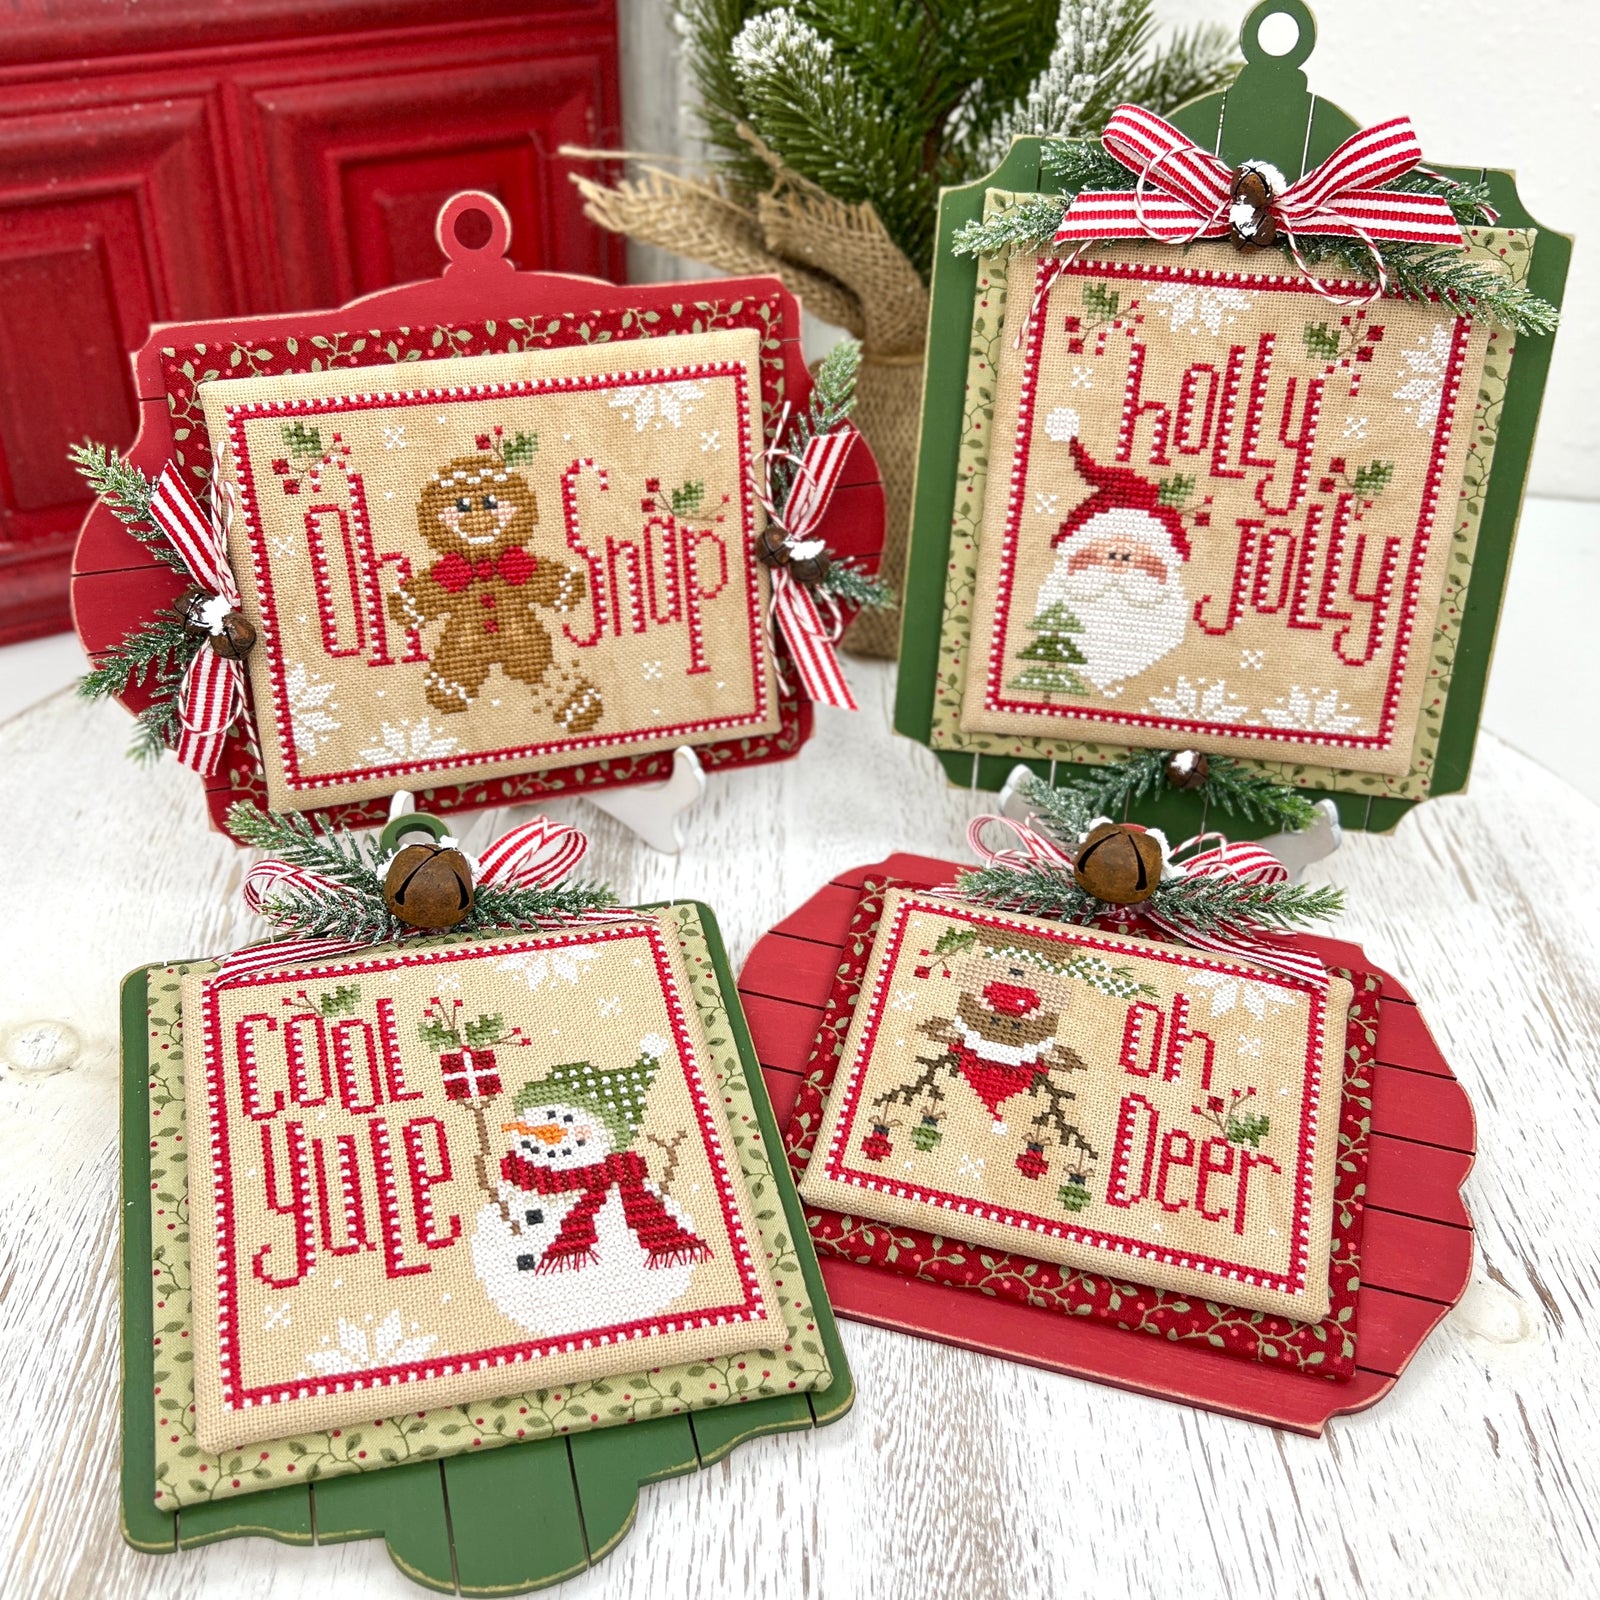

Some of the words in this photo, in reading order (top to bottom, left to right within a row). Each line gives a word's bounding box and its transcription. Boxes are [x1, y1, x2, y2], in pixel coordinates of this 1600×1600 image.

[305, 456, 430, 667] Oh
[561, 457, 729, 674] Snap
[1106, 1092, 1282, 1235] Deer
